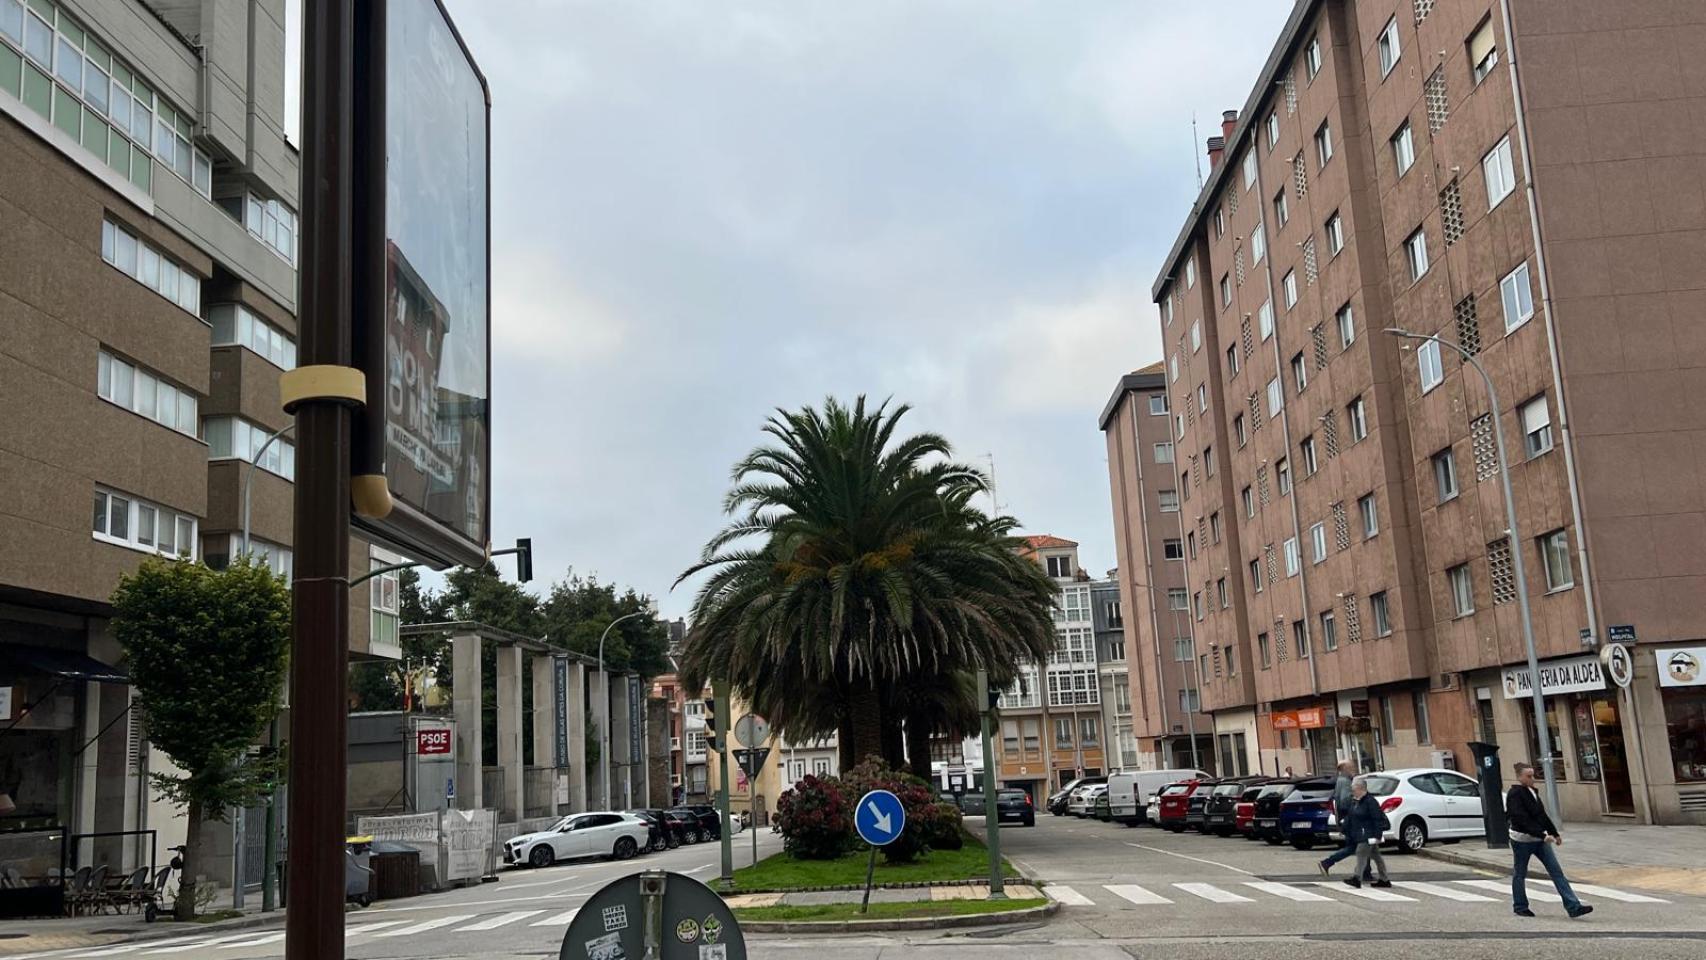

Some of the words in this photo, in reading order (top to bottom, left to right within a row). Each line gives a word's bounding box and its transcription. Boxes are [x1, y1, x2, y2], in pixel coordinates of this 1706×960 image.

[1559, 666, 1572, 685] DA
[1573, 663, 1601, 684] ALDEA
[420, 732, 448, 745] PSOE
